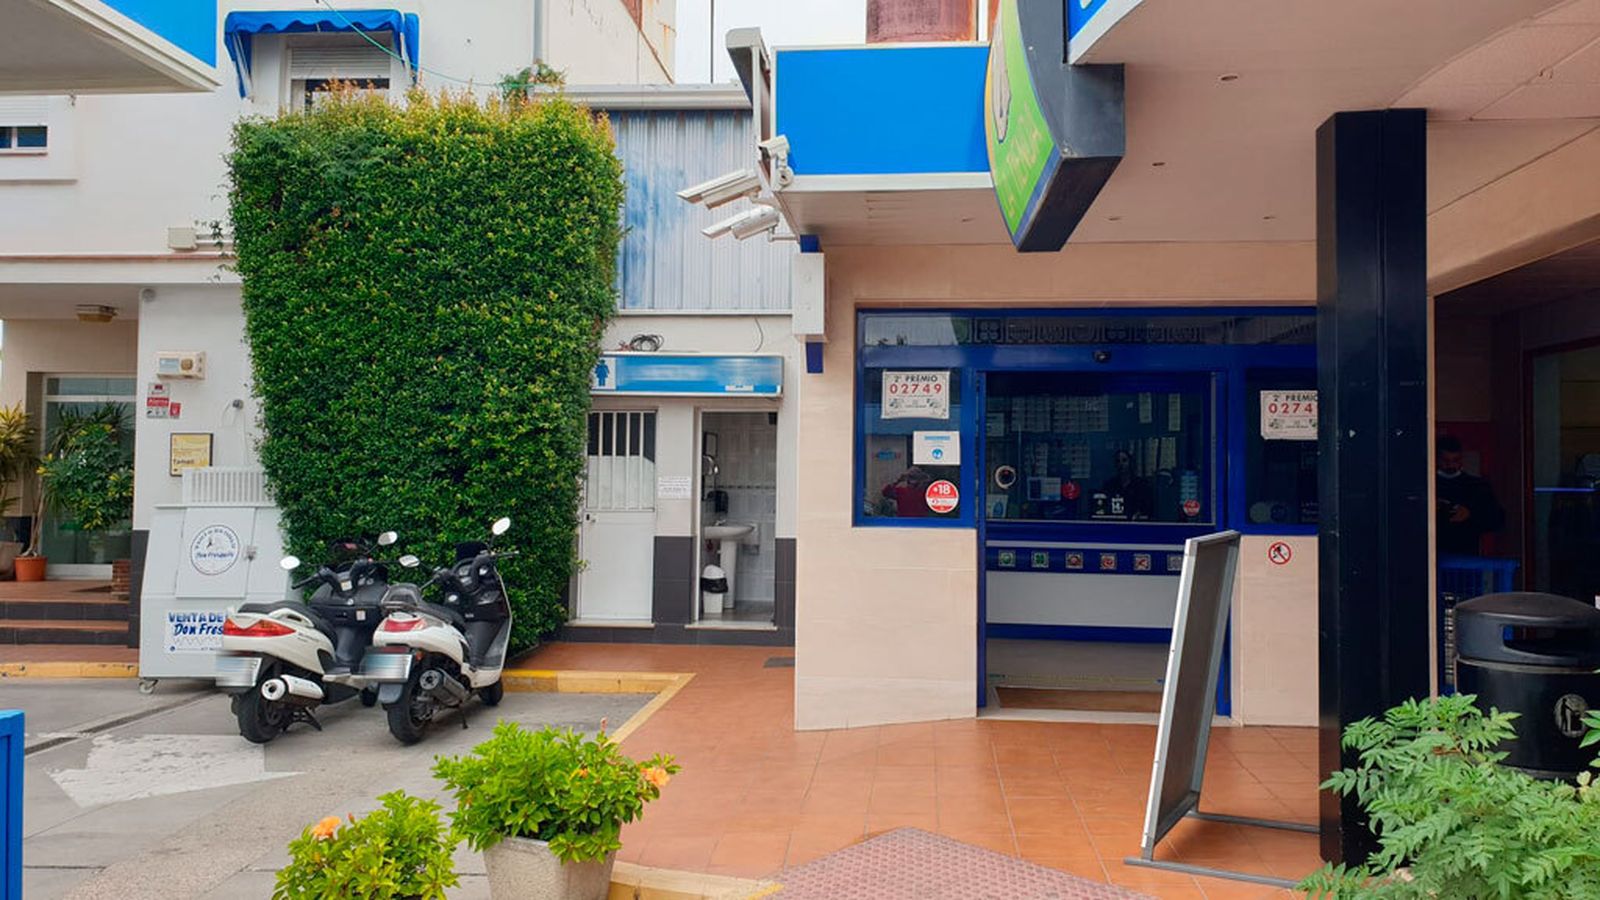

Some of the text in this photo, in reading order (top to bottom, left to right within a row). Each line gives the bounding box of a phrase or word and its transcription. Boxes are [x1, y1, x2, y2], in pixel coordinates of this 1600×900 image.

[905, 374, 938, 382] PREMIO
[890, 383, 942, 394] 02749
[168, 612, 207, 623] VENTA
[208, 612, 224, 623] DE
[174, 623, 196, 636] Don
